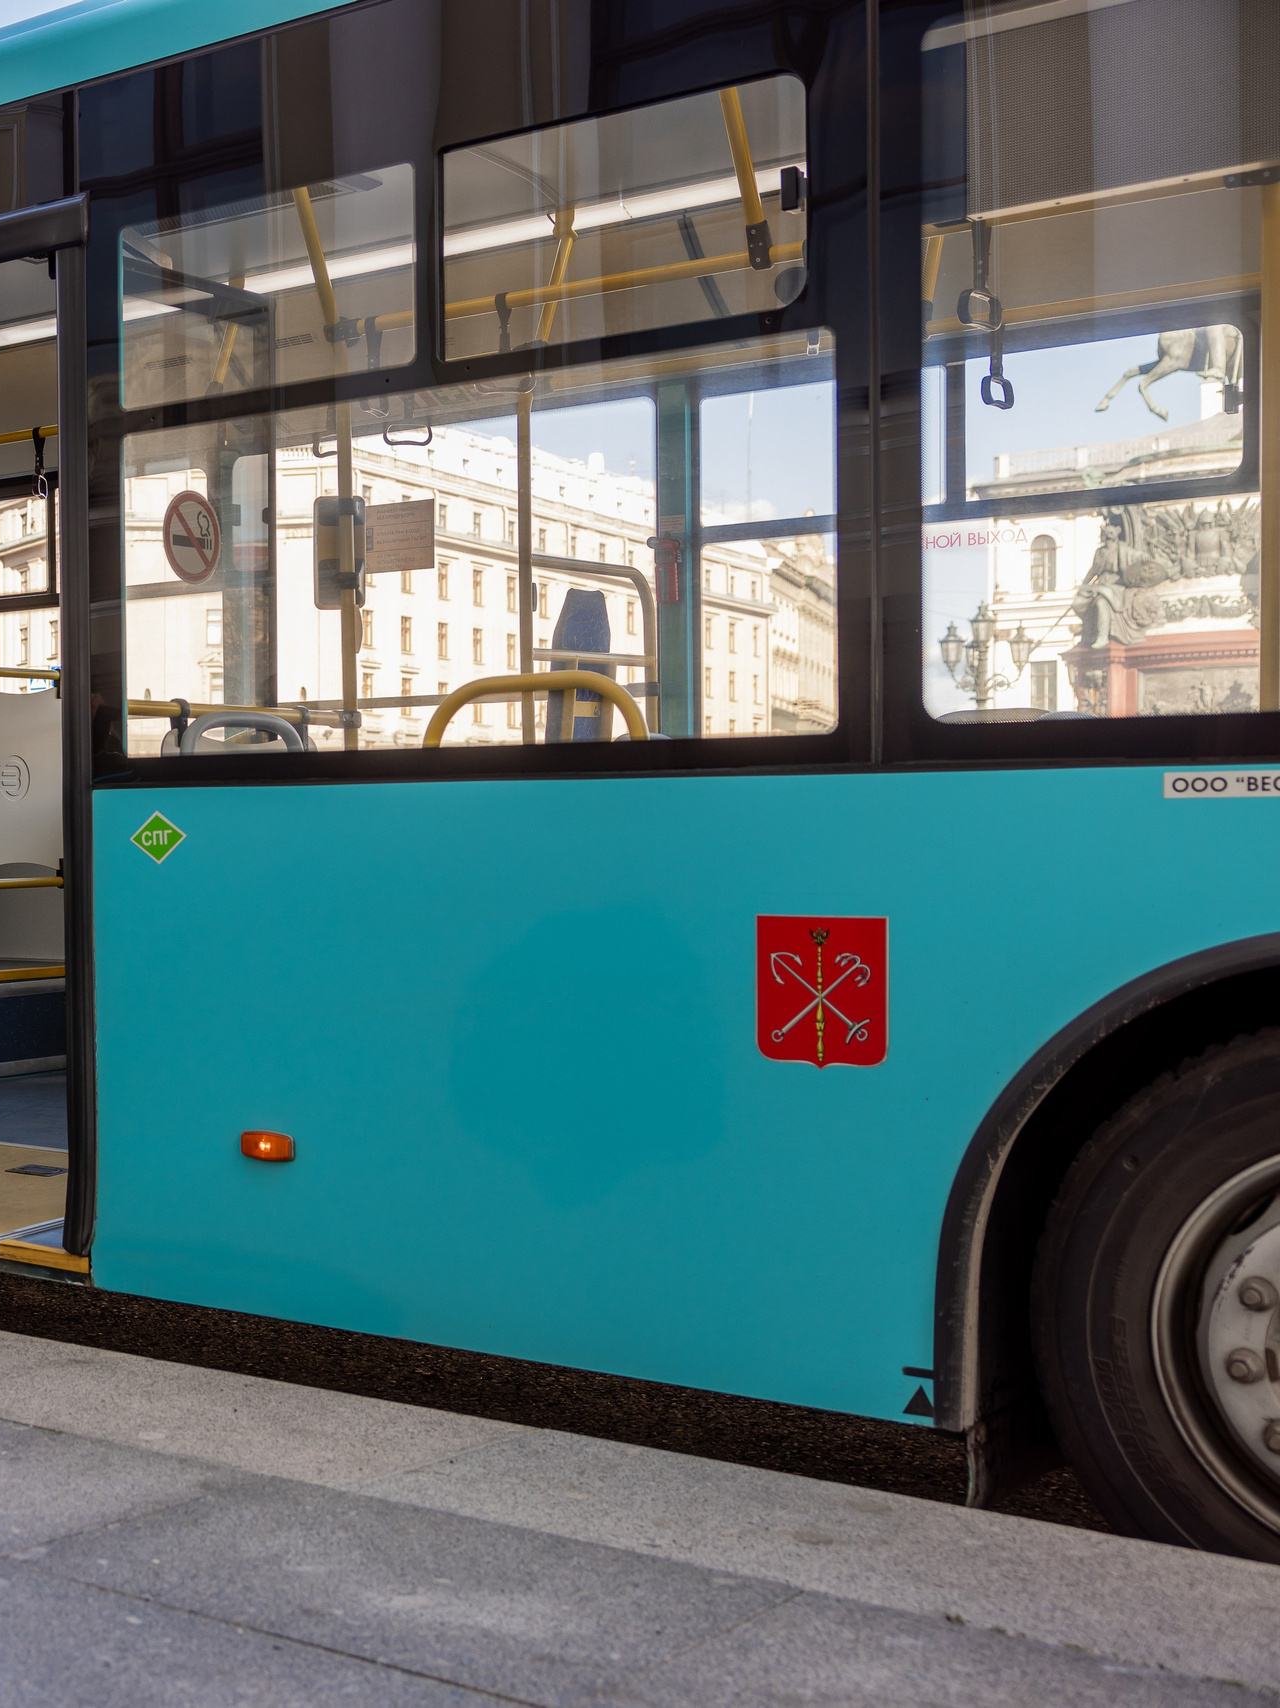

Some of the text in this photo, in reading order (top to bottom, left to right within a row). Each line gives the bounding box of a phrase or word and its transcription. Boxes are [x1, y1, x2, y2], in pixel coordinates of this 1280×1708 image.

[968, 528, 1028, 546] ВЫХОД
[1172, 777, 1228, 793] ООО
[141, 830, 173, 847] СПГ
